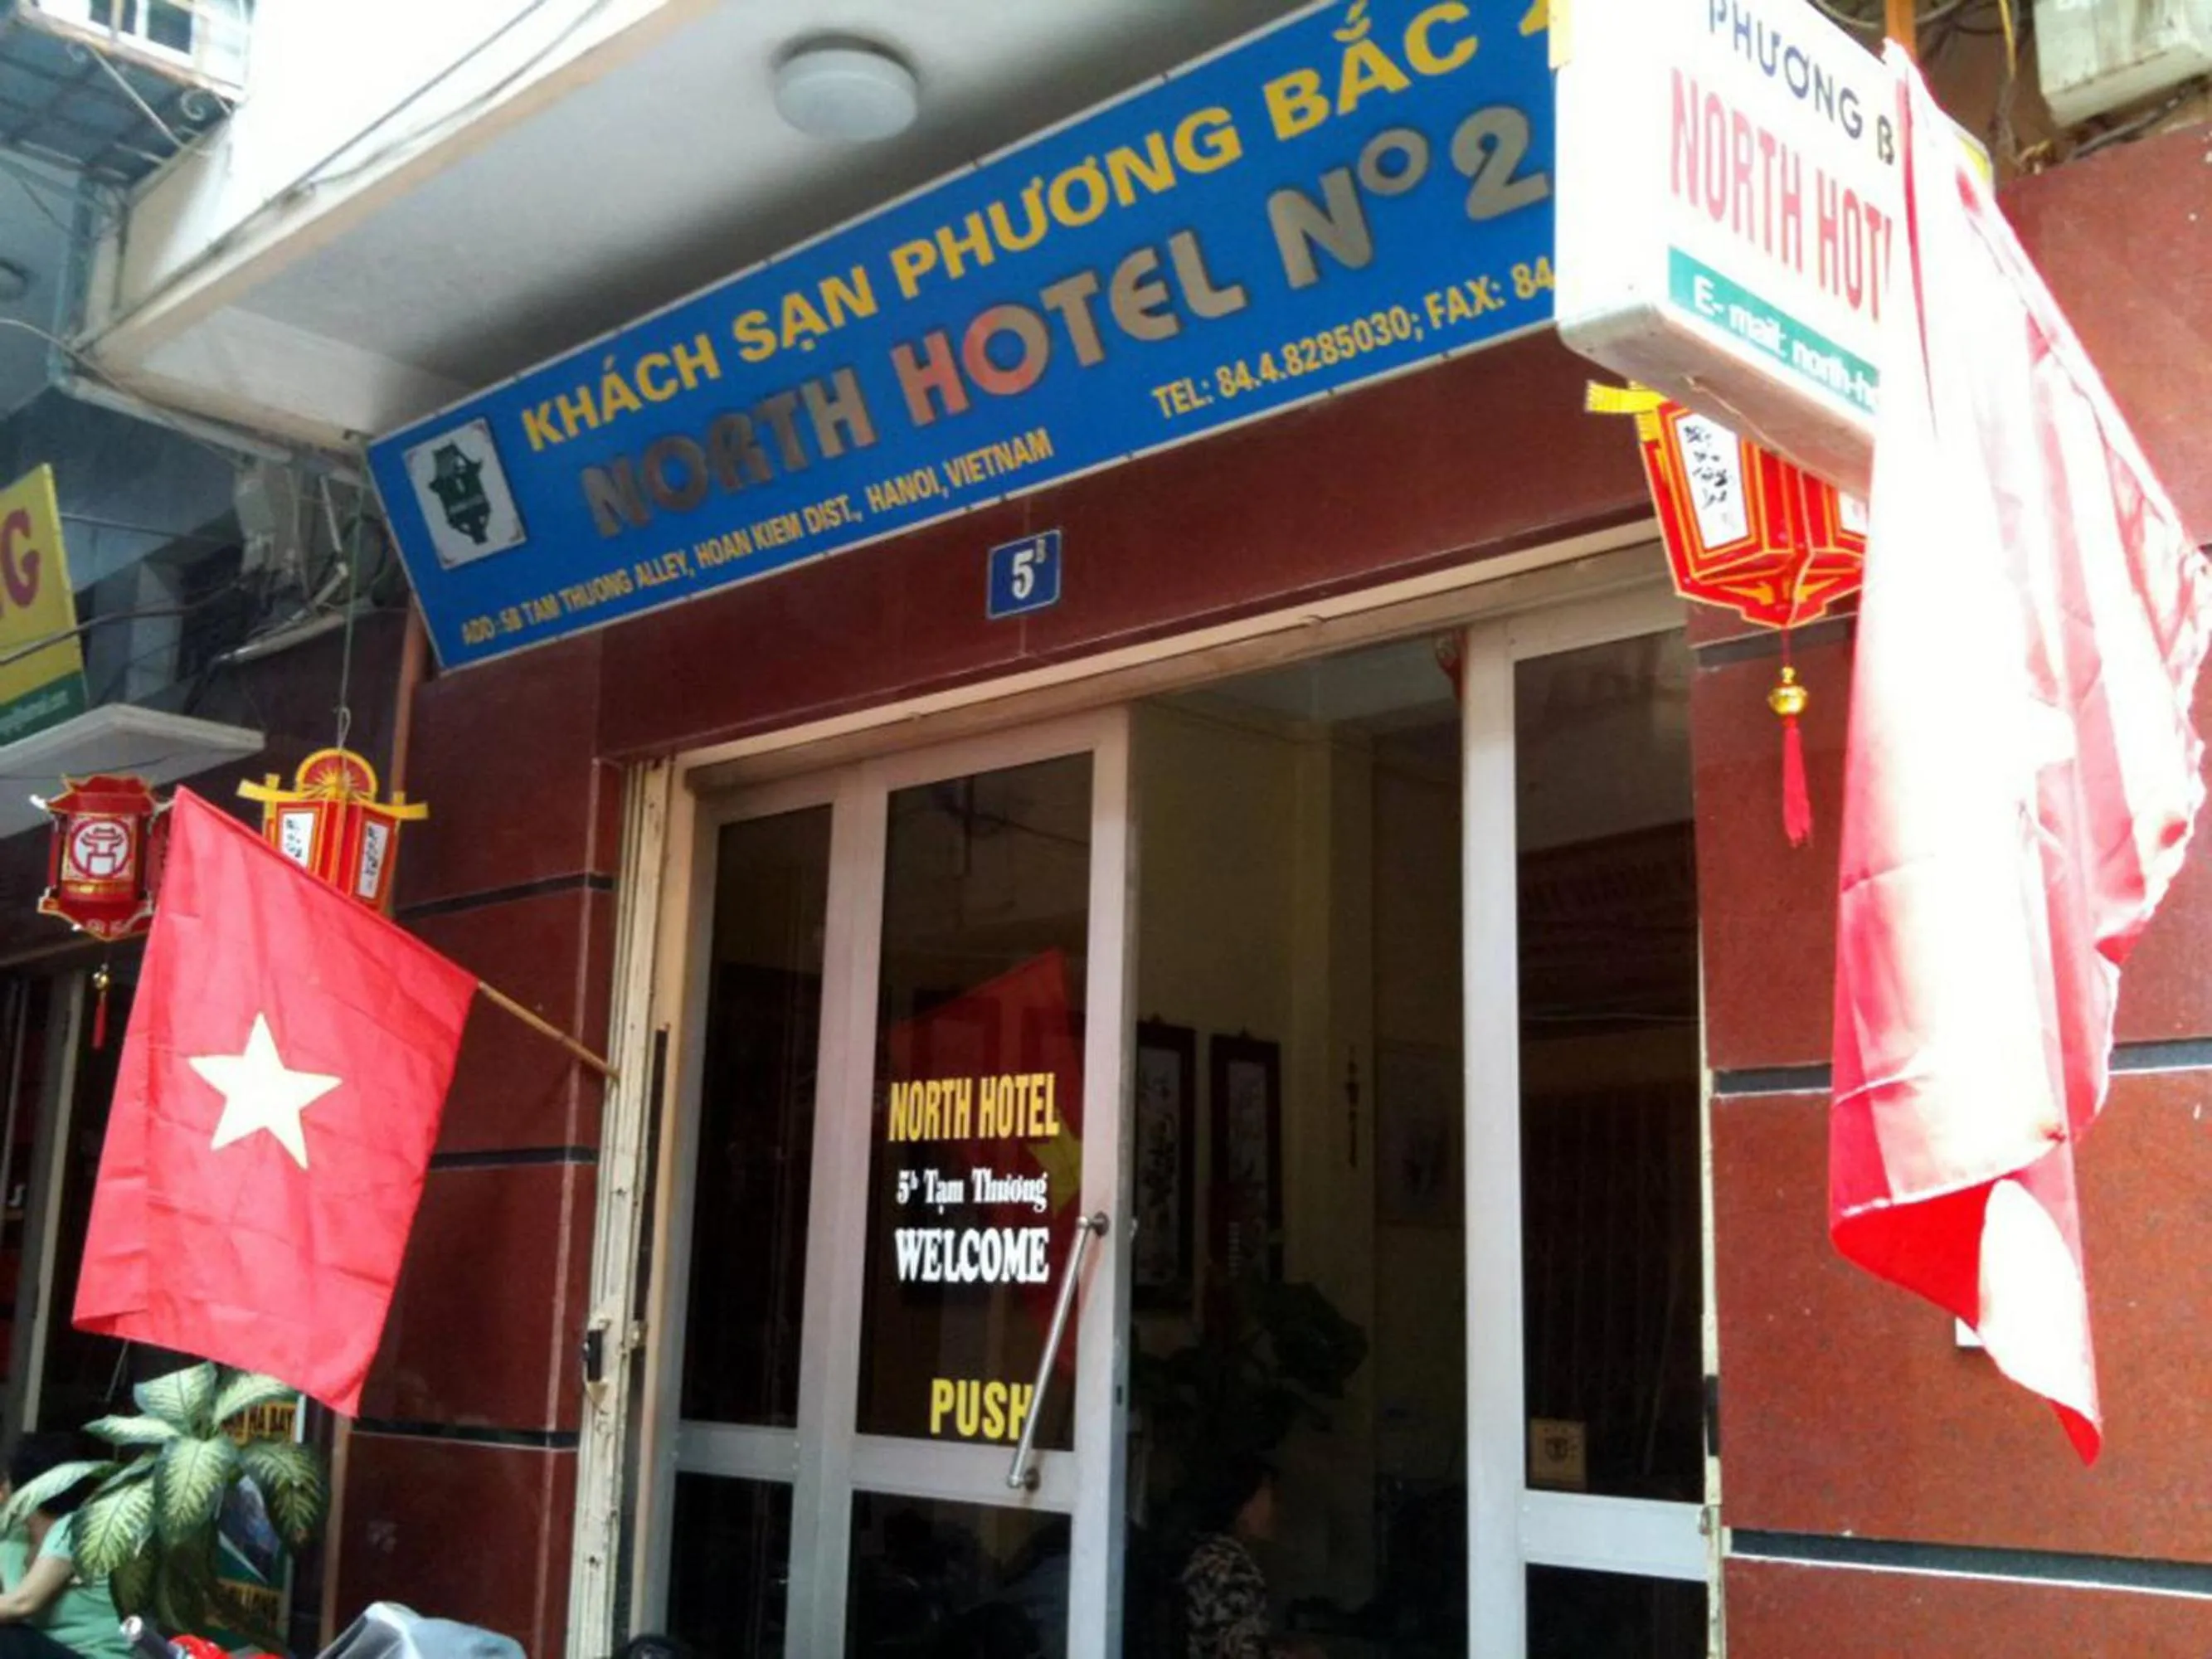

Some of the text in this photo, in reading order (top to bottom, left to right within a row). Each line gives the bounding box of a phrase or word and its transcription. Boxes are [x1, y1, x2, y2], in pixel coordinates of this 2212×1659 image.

[521, 0, 1479, 452] KHÁCH SẠN PHƯƠNG BẮC
[1670, 66, 1802, 275] NORTH
[582, 367, 877, 538] NORTH
[889, 230, 1247, 427] HOTEL
[1449, 105, 1550, 221] 2
[1150, 377, 1214, 419] TEL:
[1423, 275, 1505, 328] FAX:
[634, 548, 695, 589] ALLEY,
[693, 528, 753, 568] HOAN
[750, 511, 805, 551] KIEM
[864, 465, 950, 513] HANOI,
[941, 427, 1054, 489] VIETNAM
[888, 1073, 1060, 1142] NORTH HOTEL
[895, 1227, 1050, 1284] WELCOME
[923, 1167, 965, 1216] Tạm
[930, 1378, 1034, 1442] PUSH
